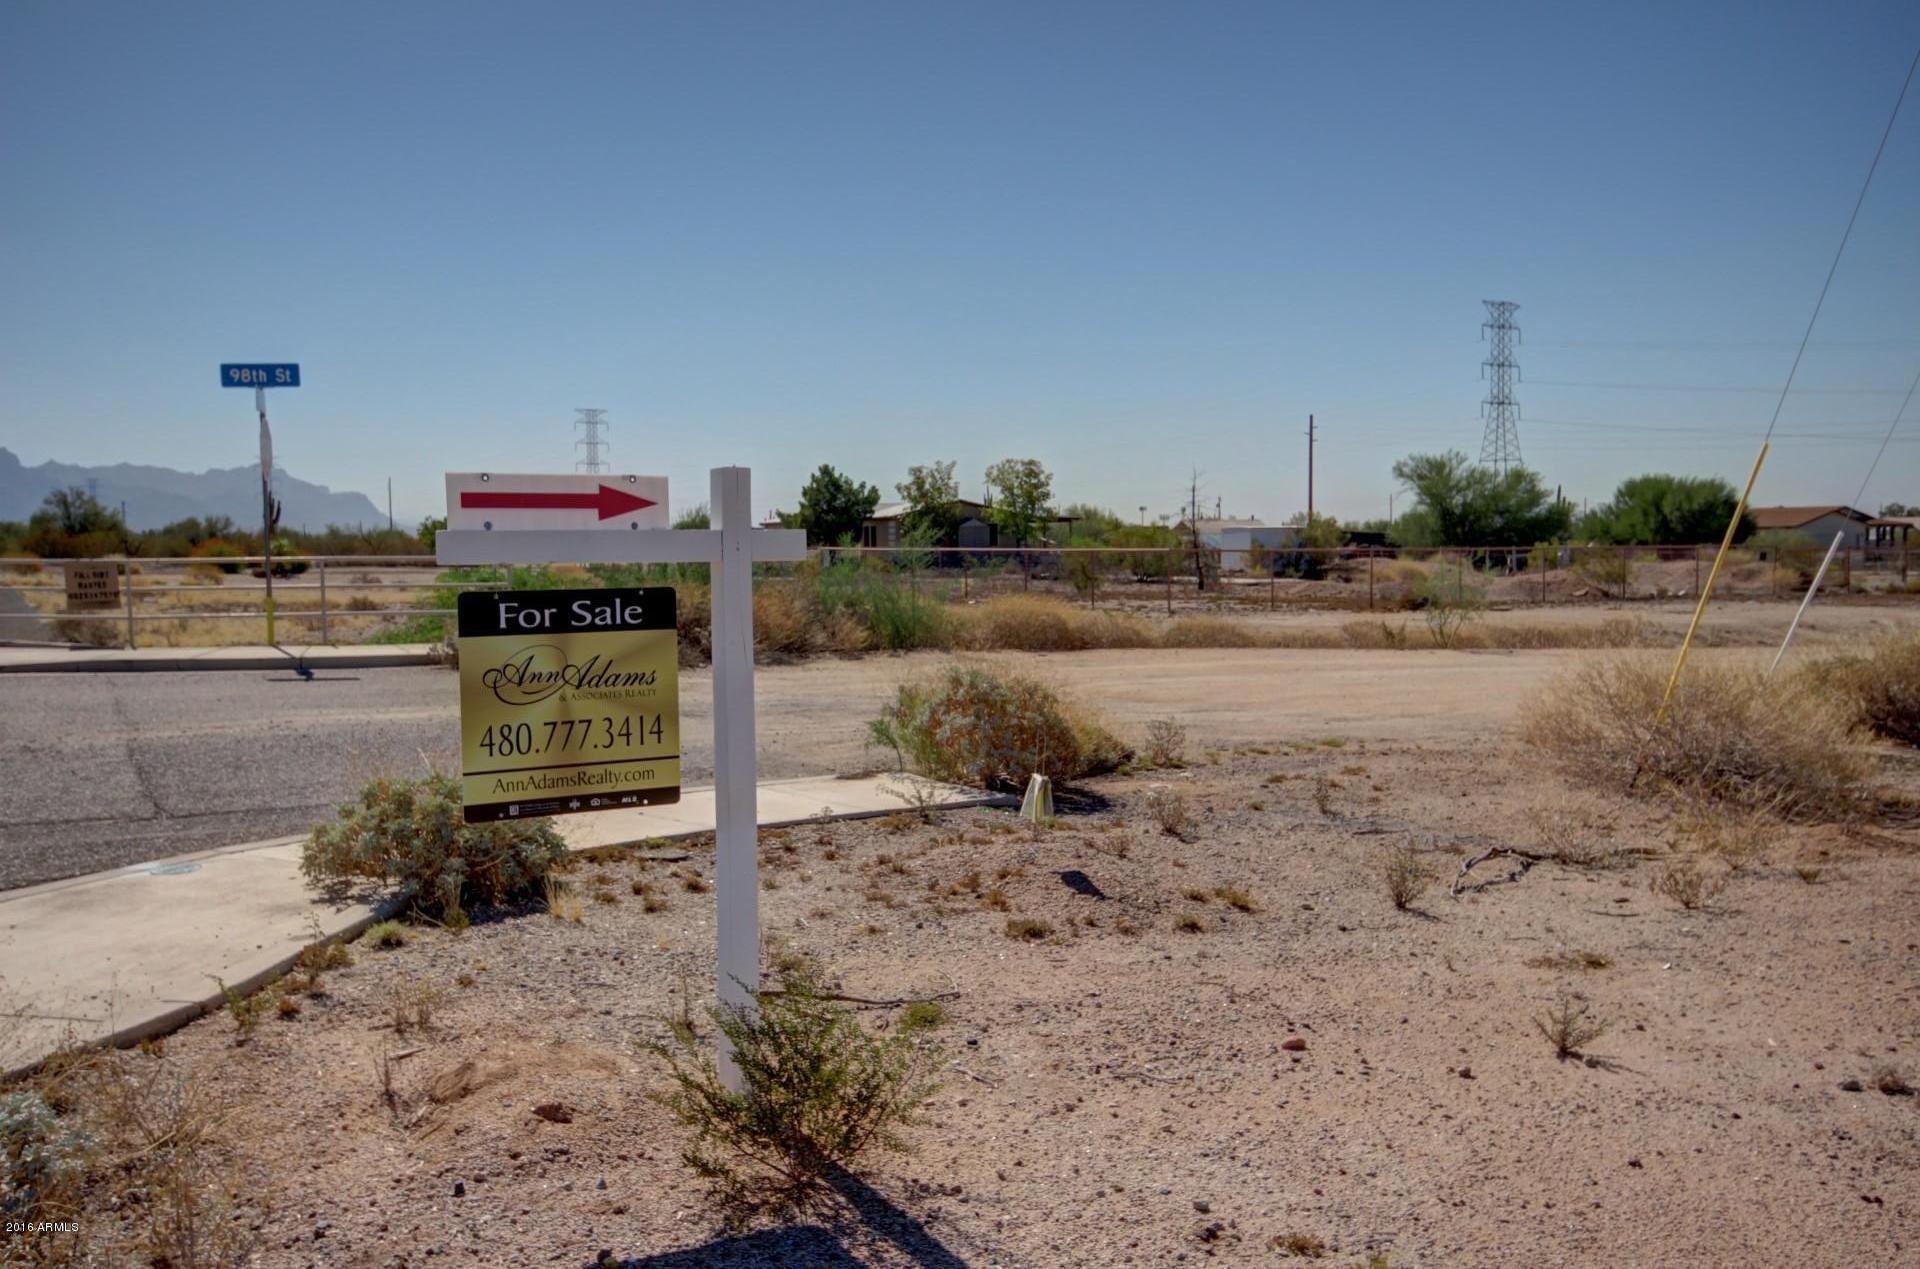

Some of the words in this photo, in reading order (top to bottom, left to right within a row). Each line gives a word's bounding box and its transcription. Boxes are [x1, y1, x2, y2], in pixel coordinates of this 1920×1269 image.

[229, 368, 267, 383] 98th
[275, 368, 292, 383] St
[499, 602, 557, 629] For
[571, 598, 643, 627] Sale
[562, 654, 657, 690] Adams
[479, 713, 664, 758] 480.777.3414
[492, 768, 655, 794] AnnAdamsRealty.com
